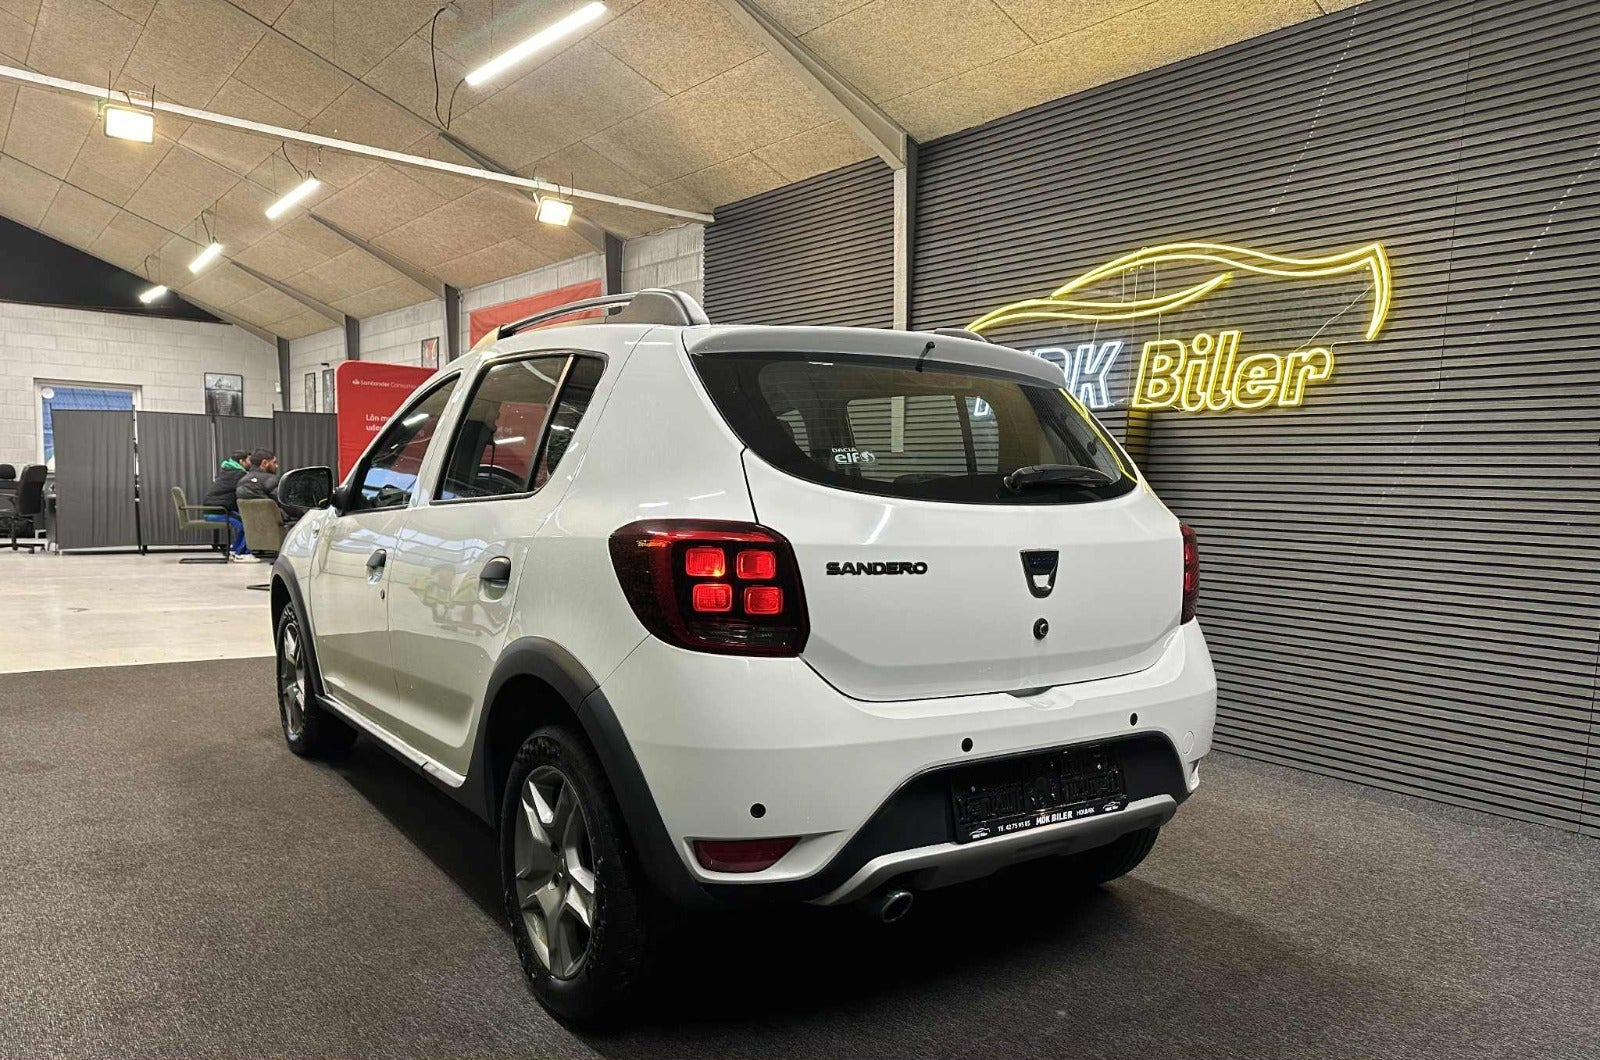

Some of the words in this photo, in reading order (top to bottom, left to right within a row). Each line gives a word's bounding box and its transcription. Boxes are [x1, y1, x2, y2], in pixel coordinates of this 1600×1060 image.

[1132, 330, 1334, 412] Biler
[360, 380, 390, 388] Santander
[366, 414, 379, 422] Lån
[826, 562, 928, 575] SANDERO
[1051, 810, 1073, 822] BILER
